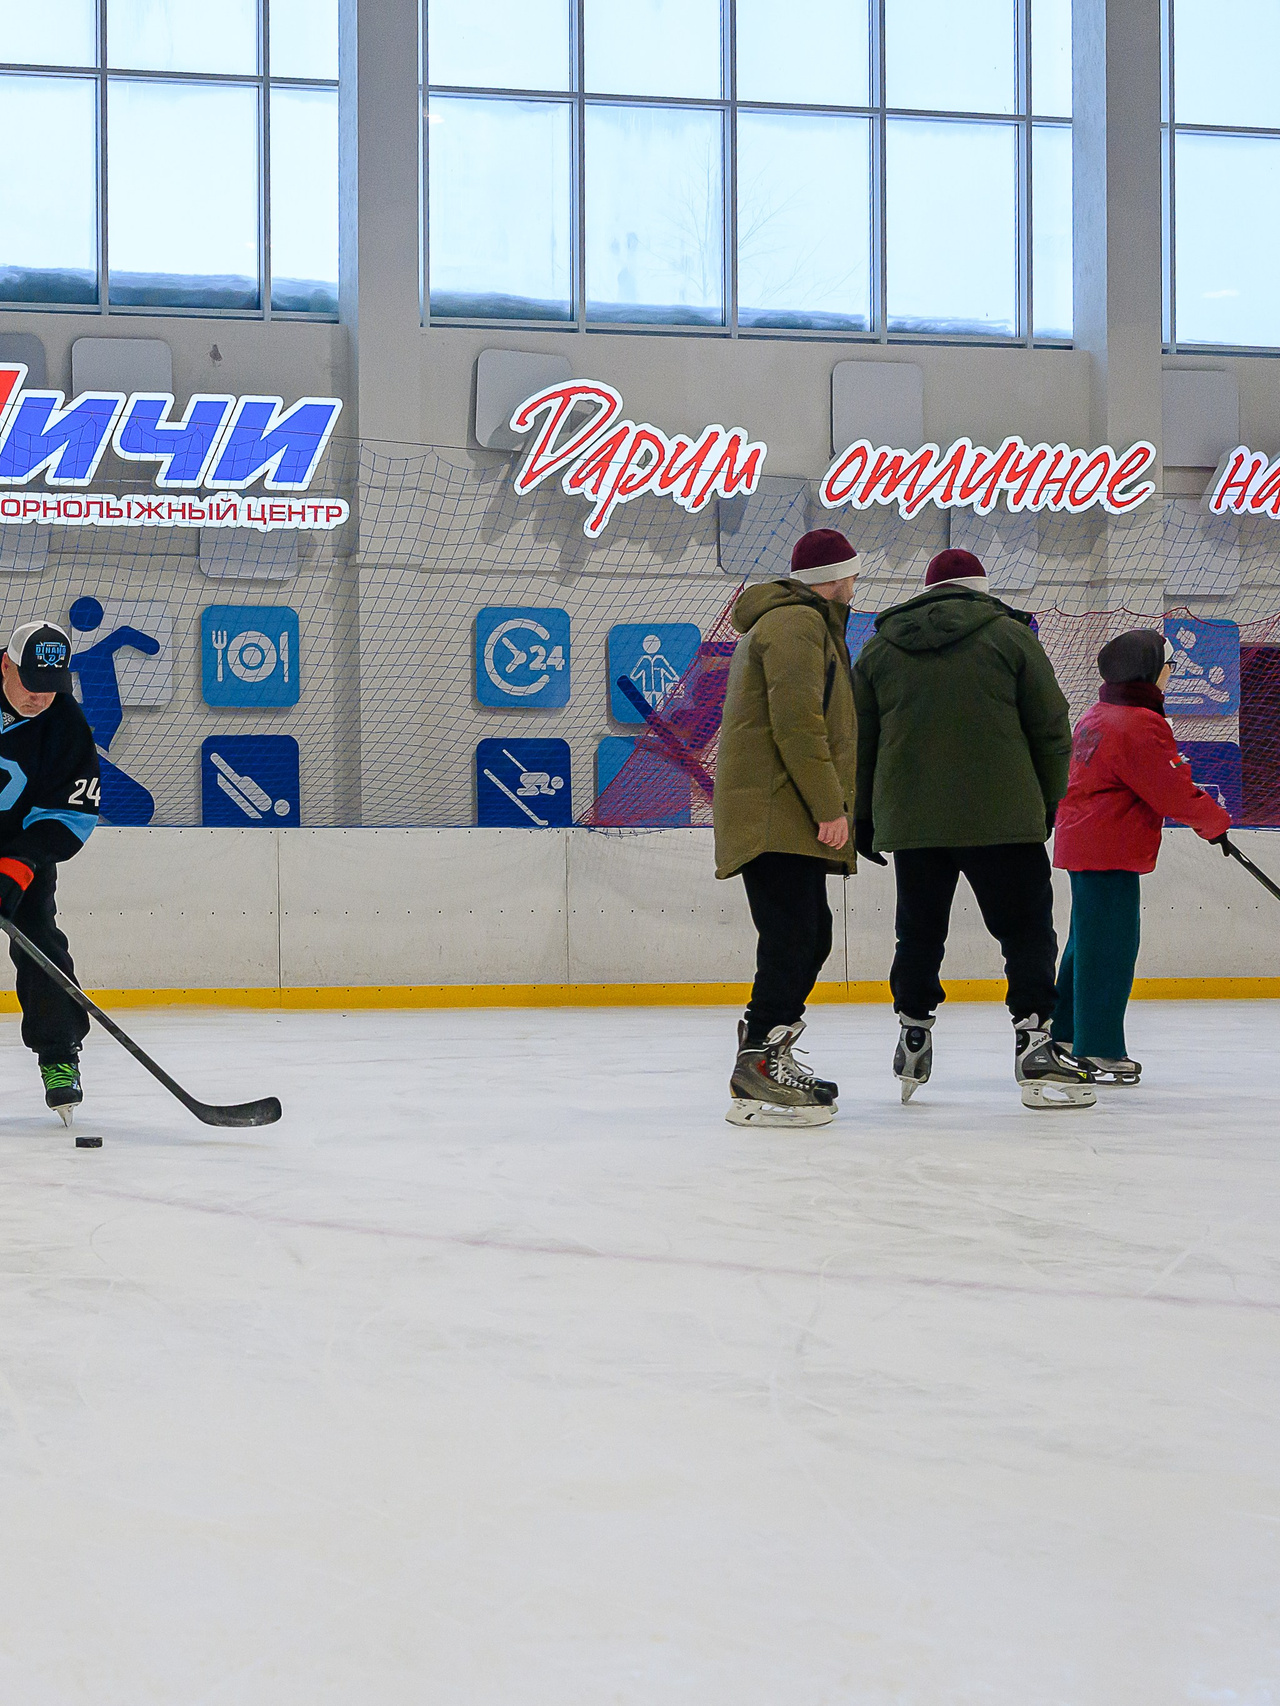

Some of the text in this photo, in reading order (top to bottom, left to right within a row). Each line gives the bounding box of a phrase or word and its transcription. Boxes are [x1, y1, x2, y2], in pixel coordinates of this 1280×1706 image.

[515, 385, 761, 532] Дарим
[824, 441, 1151, 514] отличное
[246, 502, 343, 526] ЦЕНТР
[529, 644, 565, 671] 24
[68, 777, 101, 807] 24
